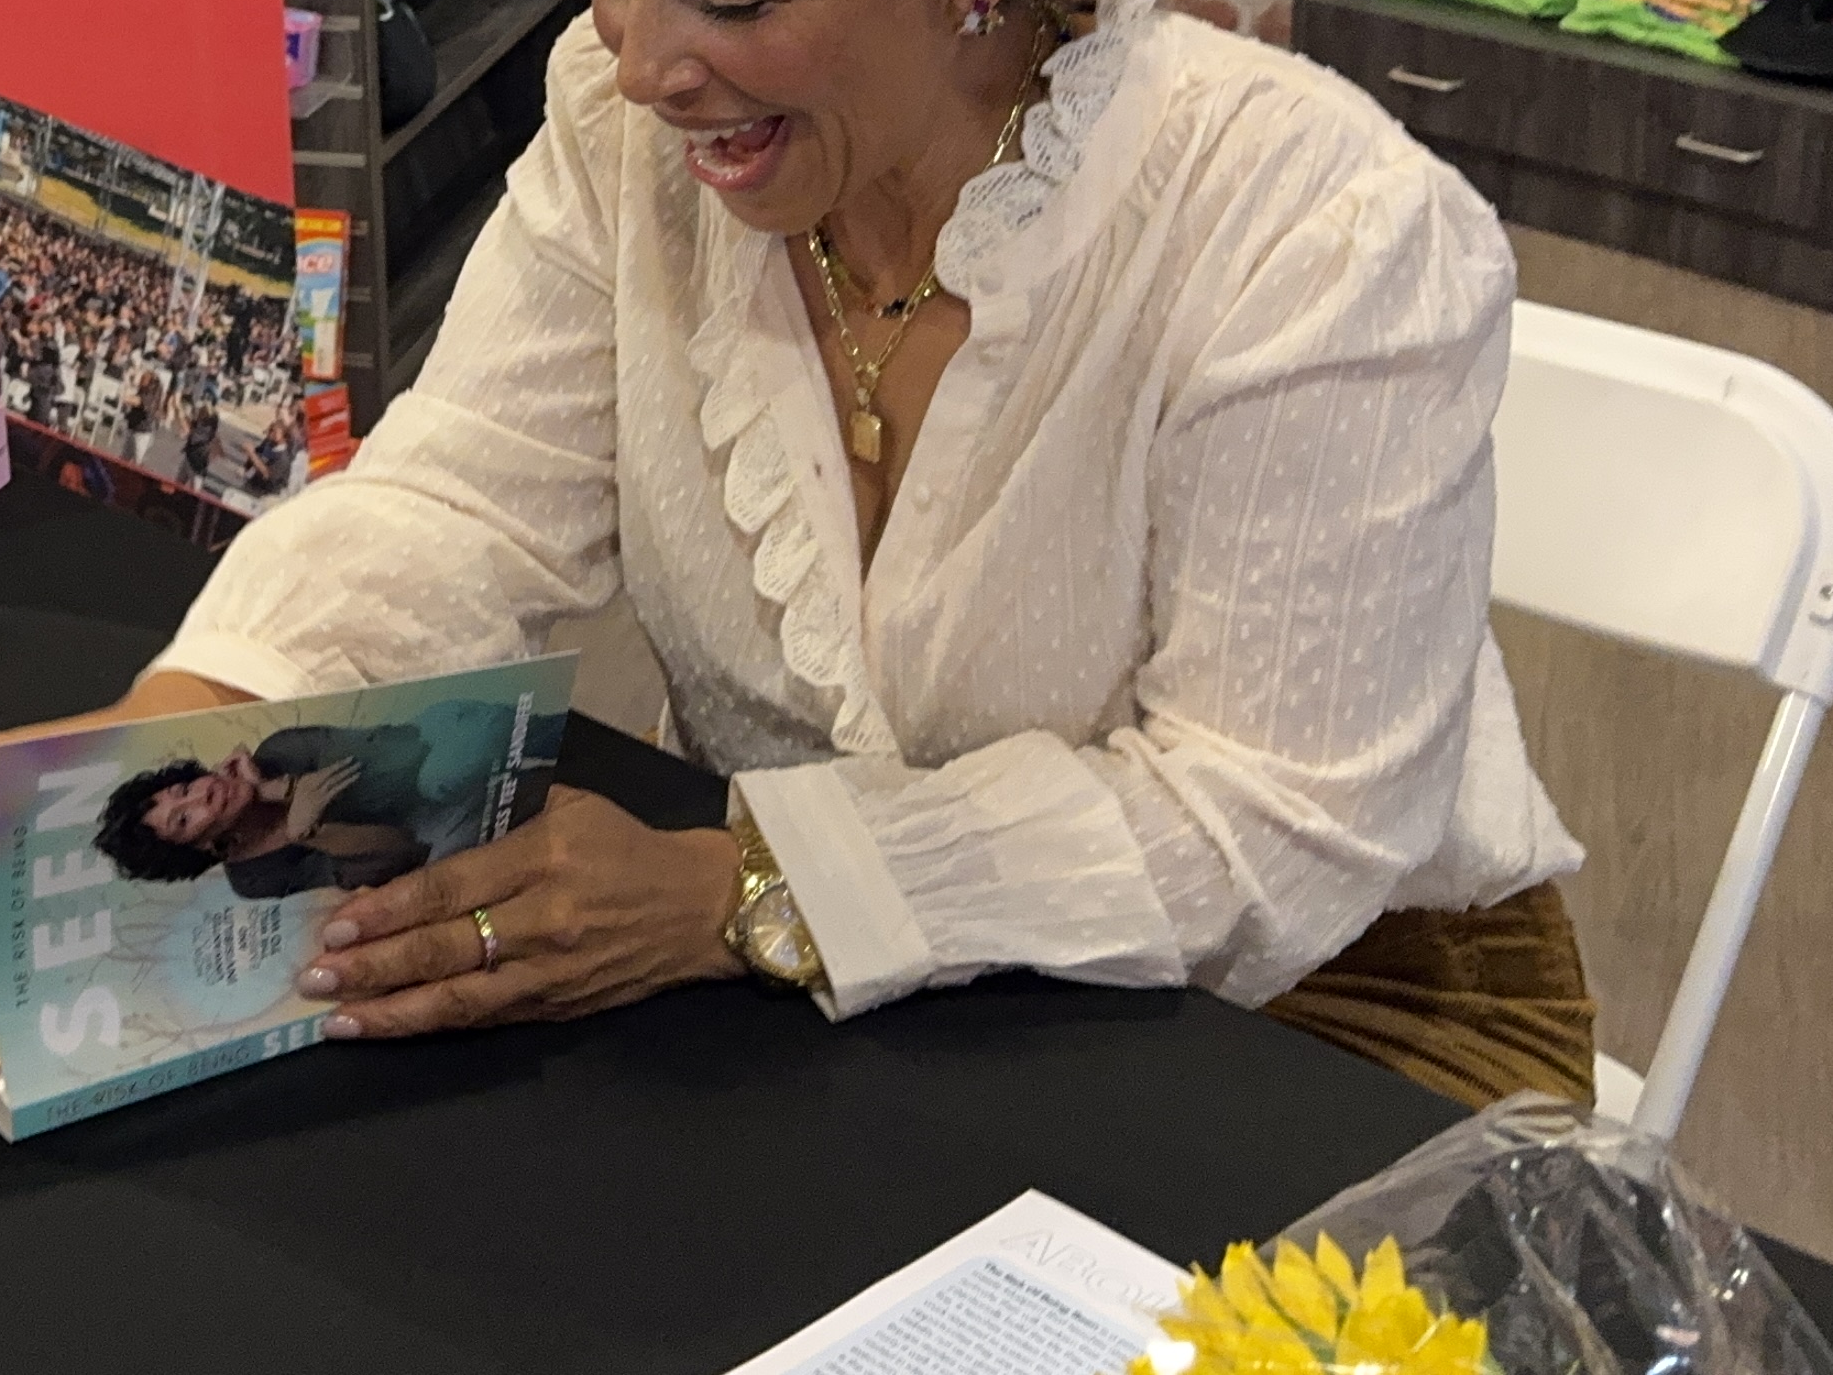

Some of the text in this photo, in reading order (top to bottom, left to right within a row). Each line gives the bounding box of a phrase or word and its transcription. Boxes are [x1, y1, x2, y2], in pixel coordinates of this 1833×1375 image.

[10, 825, 31, 1010] THE RISK OF BEING
[31, 760, 125, 1056] SEEN
[89, 1081, 139, 1107] RISK
[186, 1048, 252, 1075] BEING
